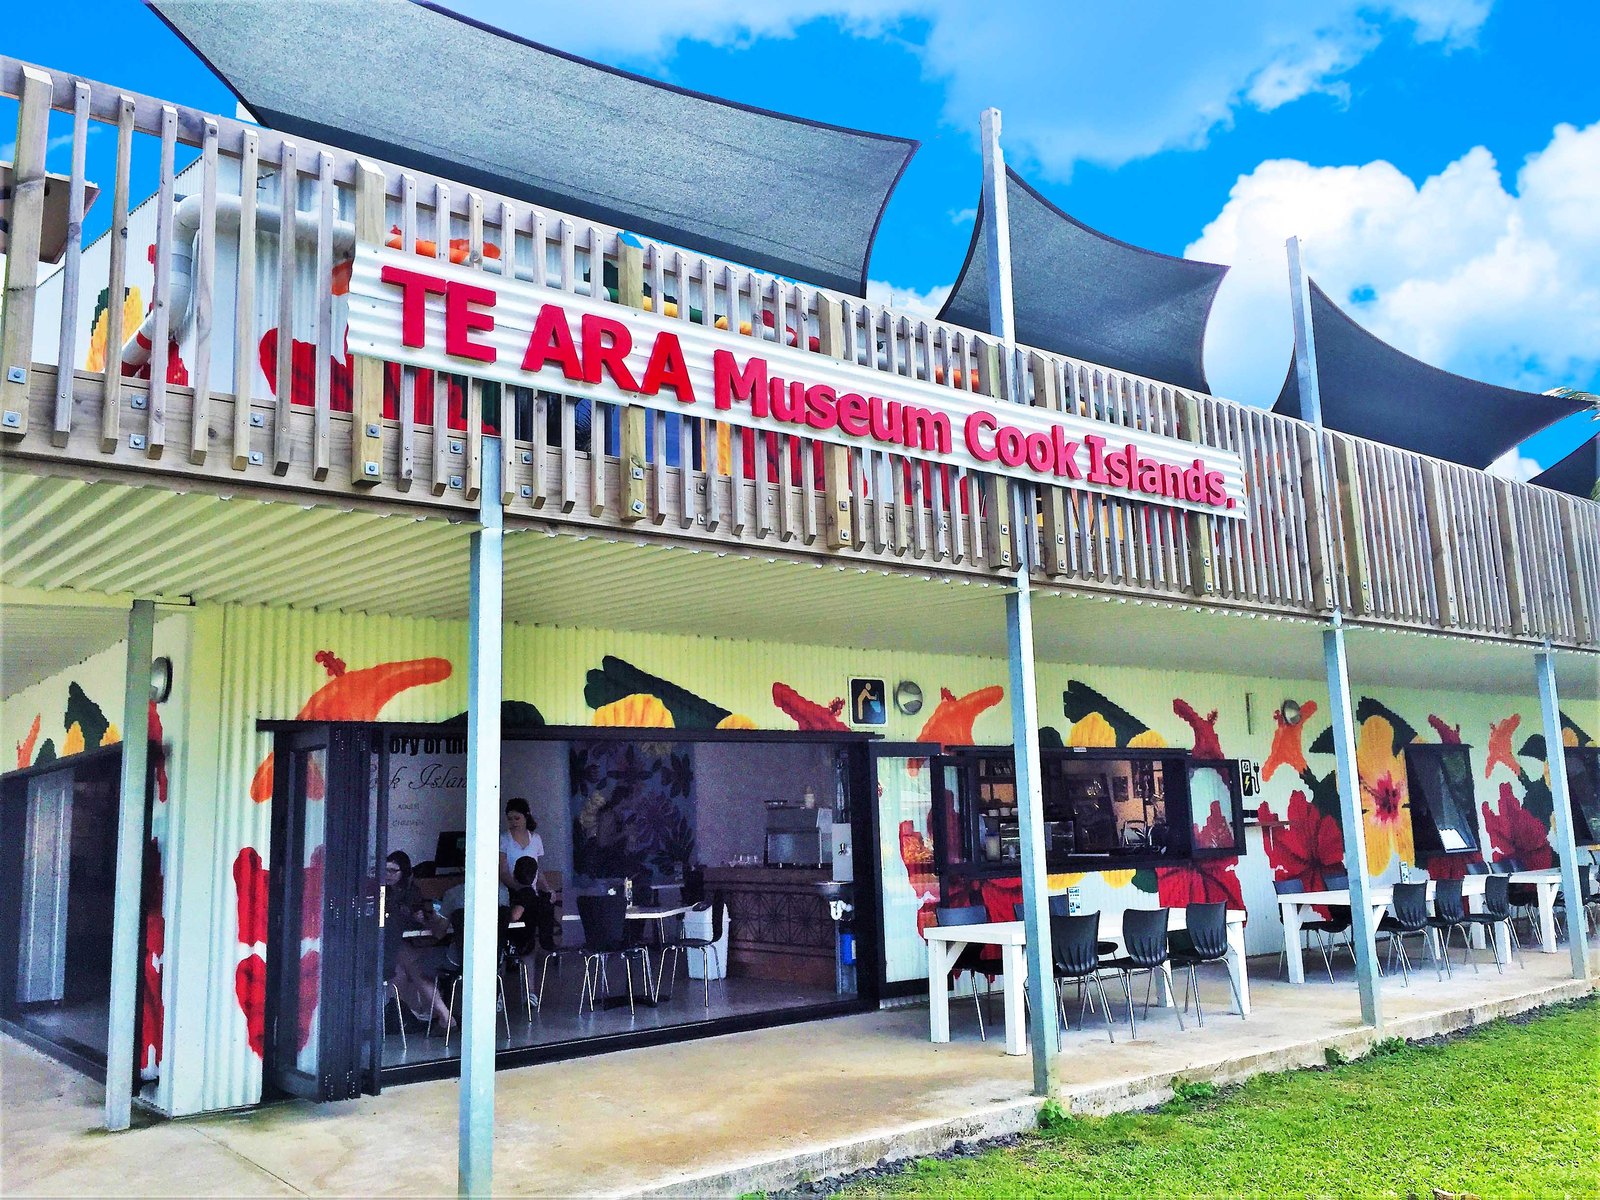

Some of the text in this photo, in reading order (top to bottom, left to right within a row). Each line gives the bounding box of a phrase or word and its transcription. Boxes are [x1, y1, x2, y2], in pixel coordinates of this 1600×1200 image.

[381, 265, 1236, 510] TE ARA Museum Cook Islands.
[408, 763, 467, 789] Islan
